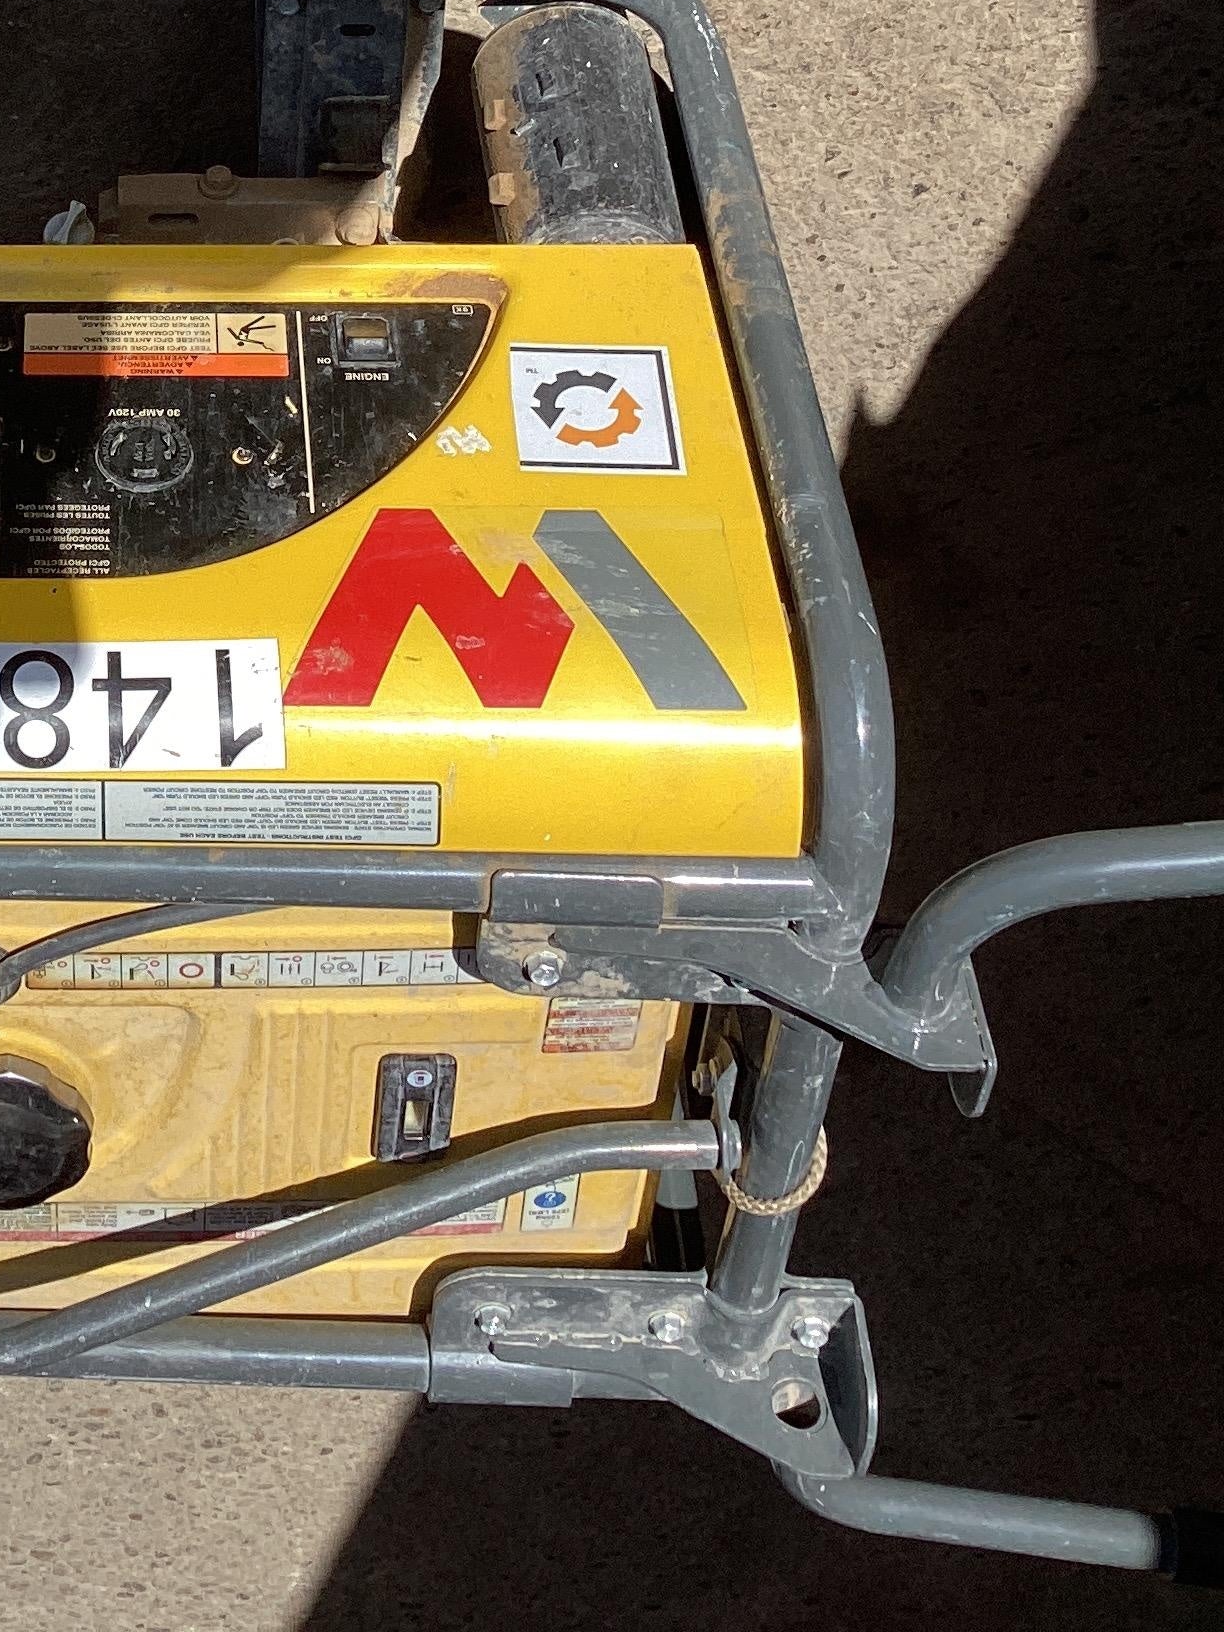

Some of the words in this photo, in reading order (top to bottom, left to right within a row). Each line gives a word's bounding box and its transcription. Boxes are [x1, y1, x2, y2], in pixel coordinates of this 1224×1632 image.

[309, 314, 328, 322] OFF
[344, 372, 389, 381] ENGINE
[108, 409, 135, 417] 120V
[138, 409, 165, 417] AMP
[167, 409, 180, 417] 30
